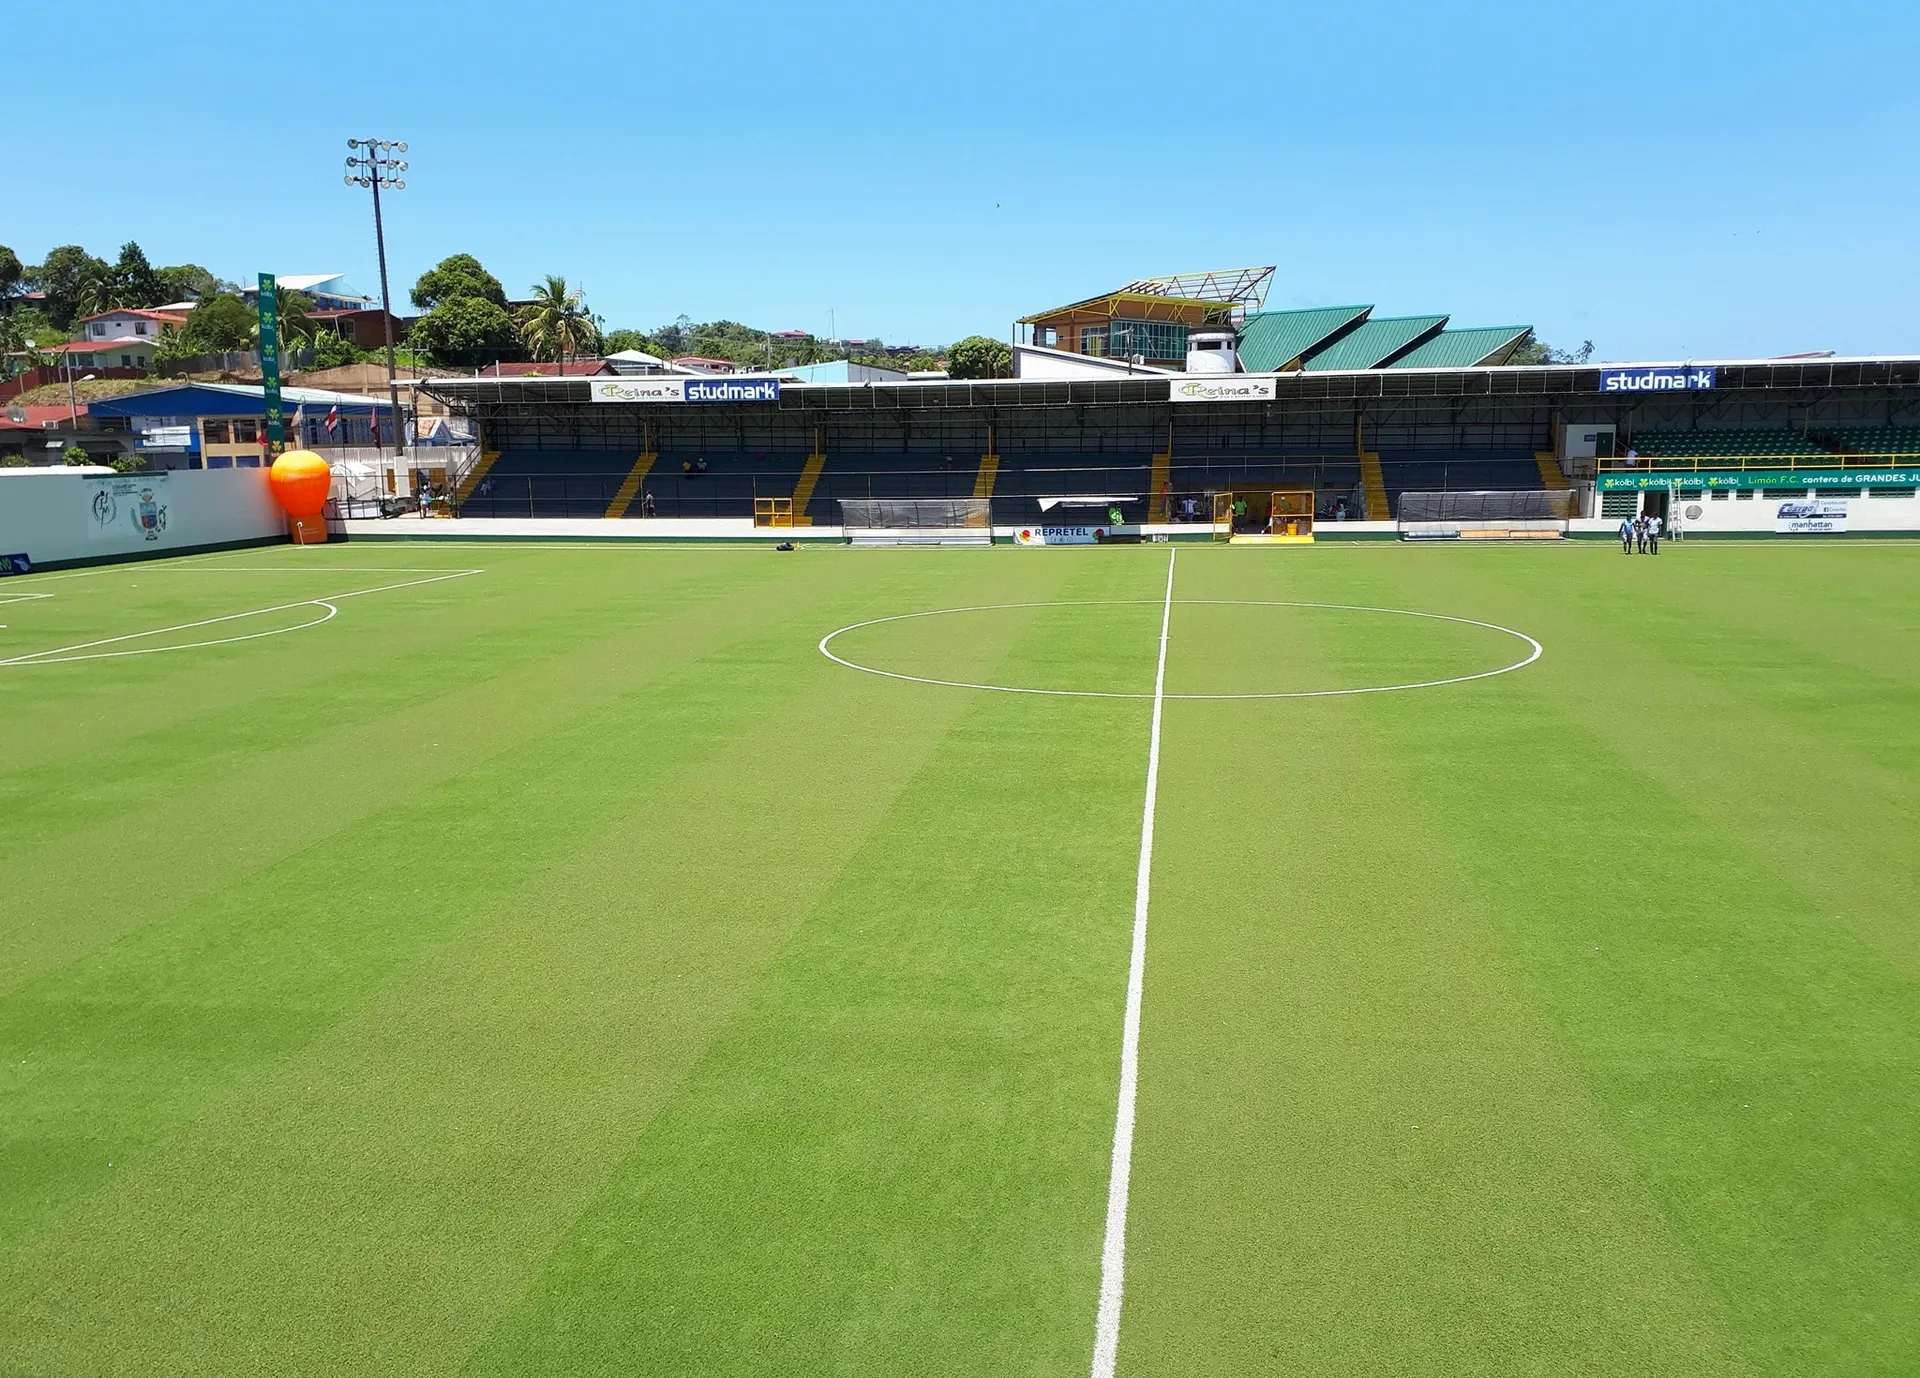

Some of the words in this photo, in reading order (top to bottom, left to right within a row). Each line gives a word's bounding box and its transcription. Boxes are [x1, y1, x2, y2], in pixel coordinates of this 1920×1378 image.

[1606, 371, 1711, 390] studmark
[598, 384, 679, 399] Reina's
[688, 382, 776, 399] studmark
[1178, 383, 1269, 399] Reina's
[1748, 476, 1777, 484] Limón
[1802, 475, 1838, 483] cantera
[1841, 474, 1853, 483] de
[1855, 474, 1906, 483] GRANDES
[1791, 519, 1833, 528] manhattan
[1034, 527, 1089, 537] REPRETEL
